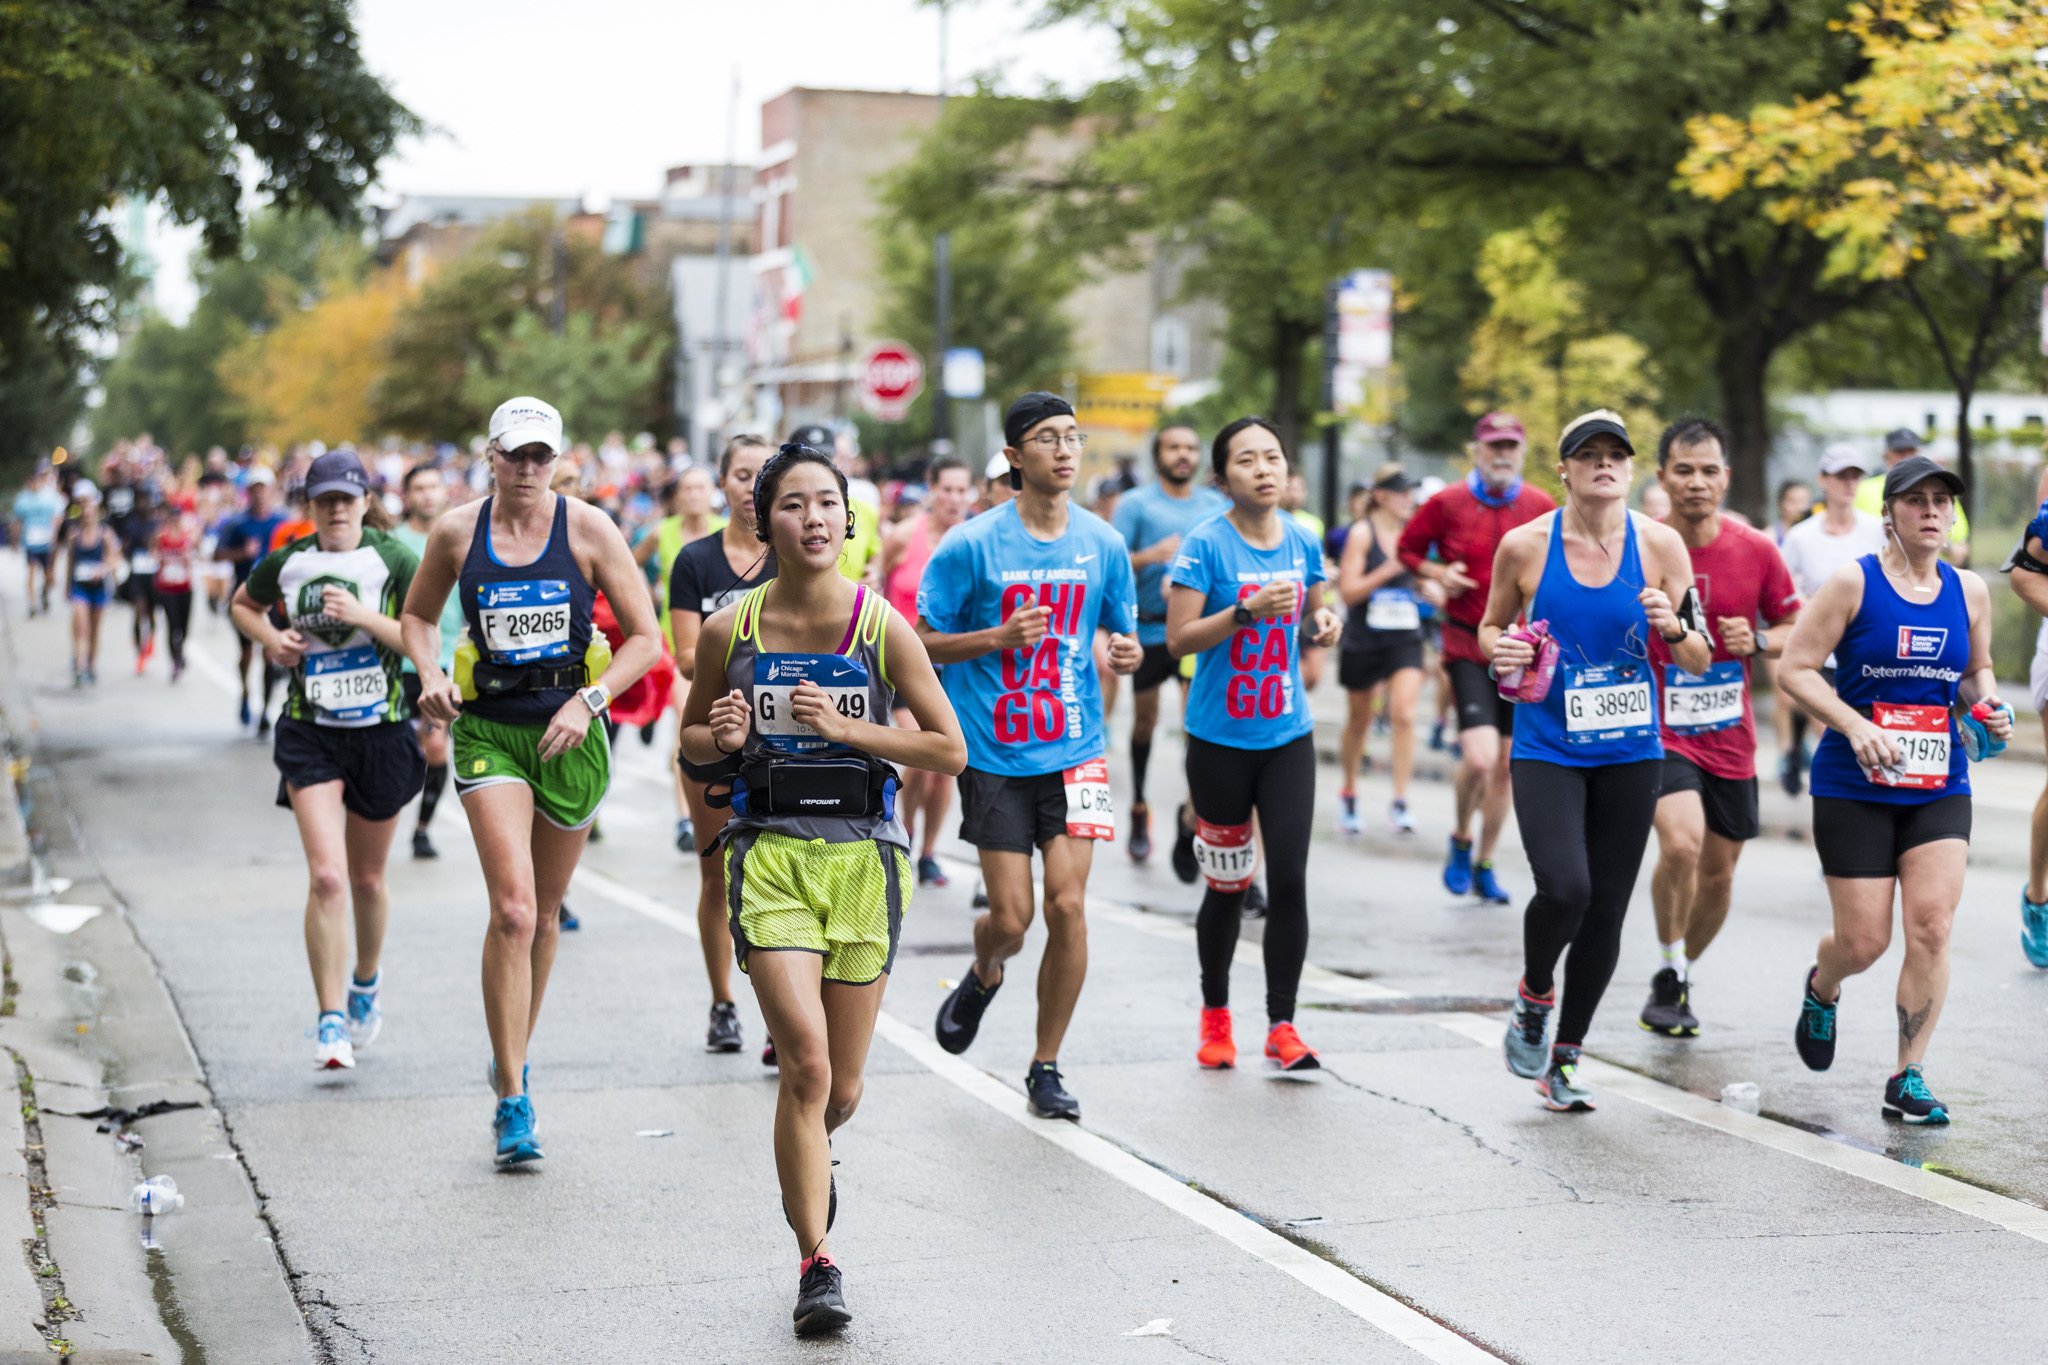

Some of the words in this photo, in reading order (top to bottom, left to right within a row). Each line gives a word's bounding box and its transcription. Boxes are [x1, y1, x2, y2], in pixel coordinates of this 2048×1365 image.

[1002, 570, 1030, 581] BANK
[1032, 570, 1045, 580] OF
[1047, 569, 1087, 580] AMERICA
[1237, 572, 1259, 582] BANK
[1259, 572, 1270, 581] OF
[486, 615, 496, 638] F
[507, 611, 565, 637] 28265
[1229, 627, 1289, 672] CA
[1911, 635, 1941, 643] American
[1001, 637, 1061, 690] CA
[1862, 664, 1962, 683] DetermiNation
[311, 681, 321, 700] G
[333, 672, 384, 698] 31826
[1226, 674, 1284, 719] GO
[759, 692, 776, 720] G
[993, 690, 1066, 743] GO
[1570, 696, 1583, 718] G
[1595, 690, 1647, 716] 38920
[1671, 693, 1679, 712] F
[1067, 705, 1082, 739] 2018
[1081, 788, 1091, 809] C
